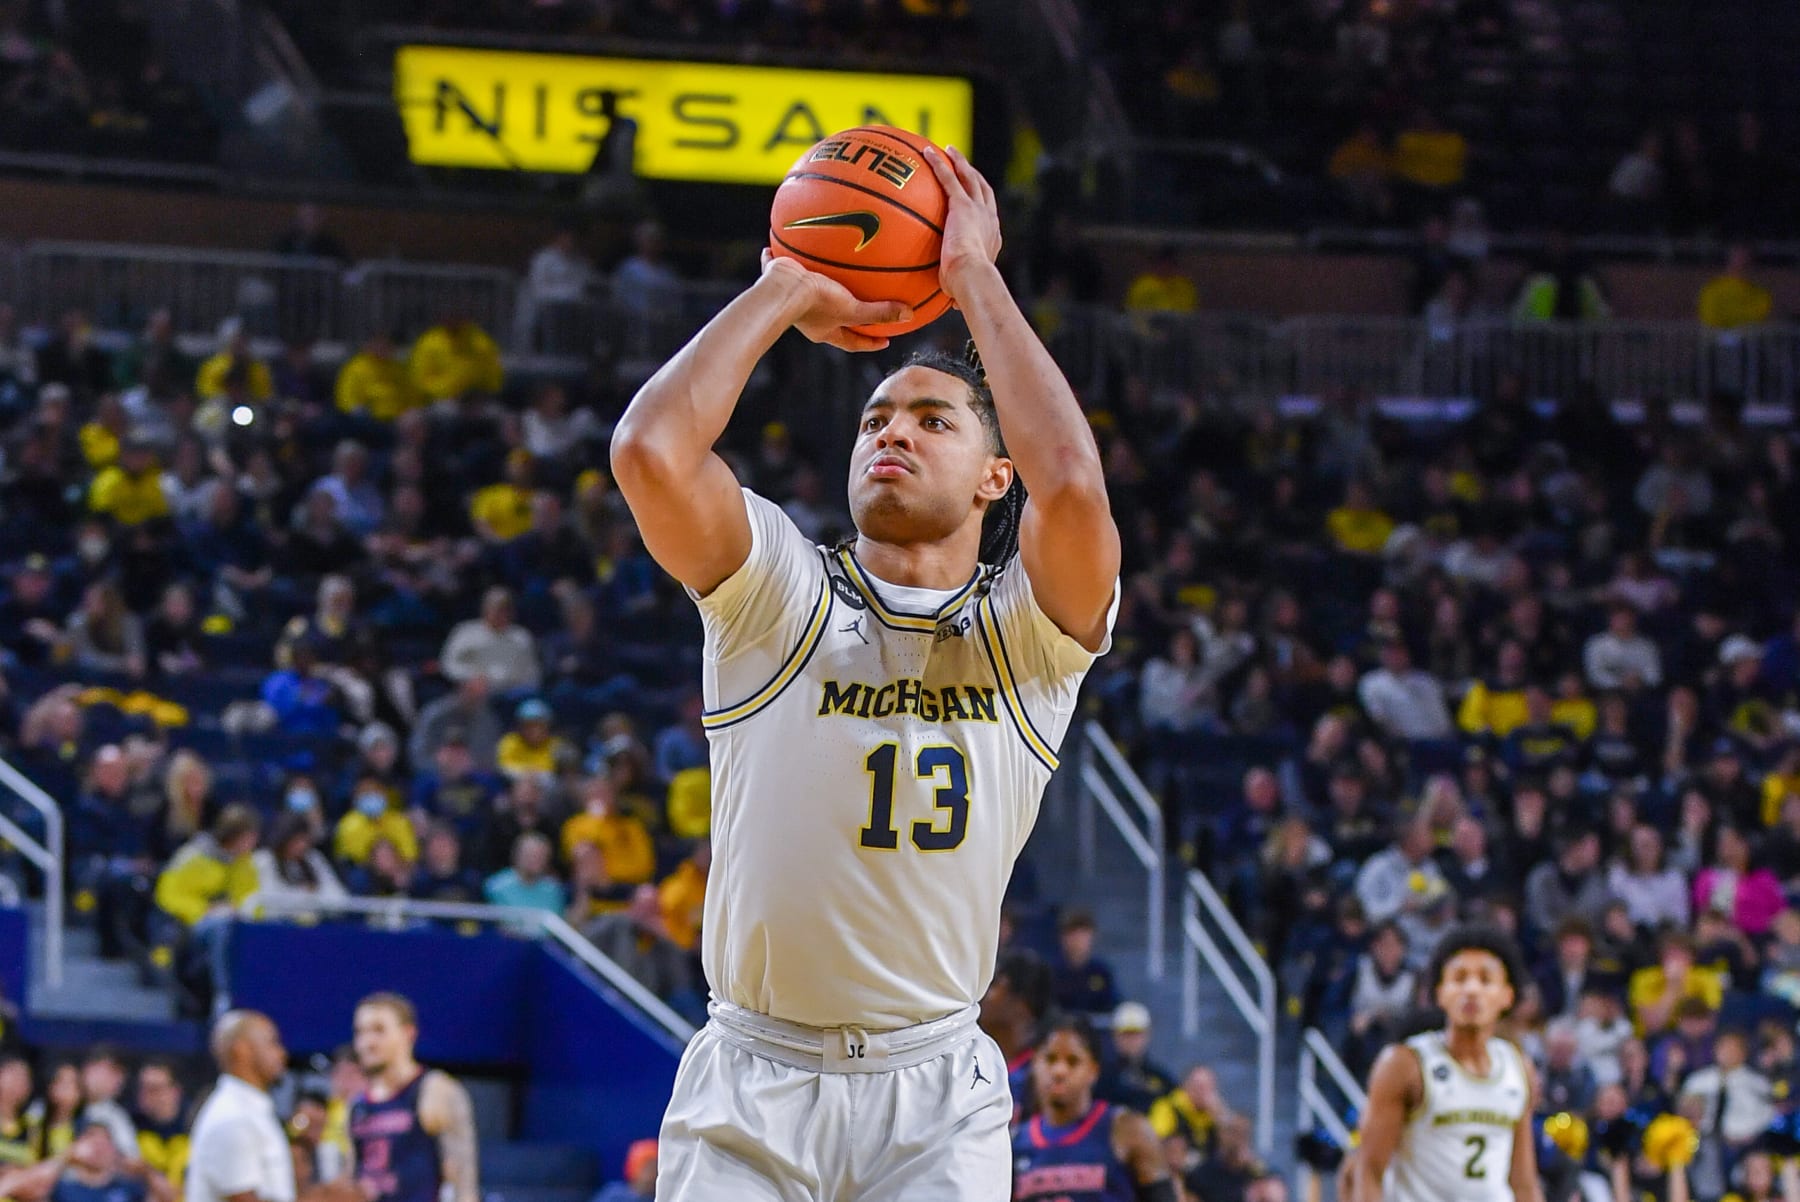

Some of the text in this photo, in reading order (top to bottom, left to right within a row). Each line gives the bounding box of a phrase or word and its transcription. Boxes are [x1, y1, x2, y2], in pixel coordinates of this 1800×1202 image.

[809, 140, 916, 189] ELITE
[836, 580, 863, 604] BLM
[817, 678, 1000, 724] MICHGAN
[858, 739, 972, 853] 13
[1463, 1134, 1487, 1179] 2
